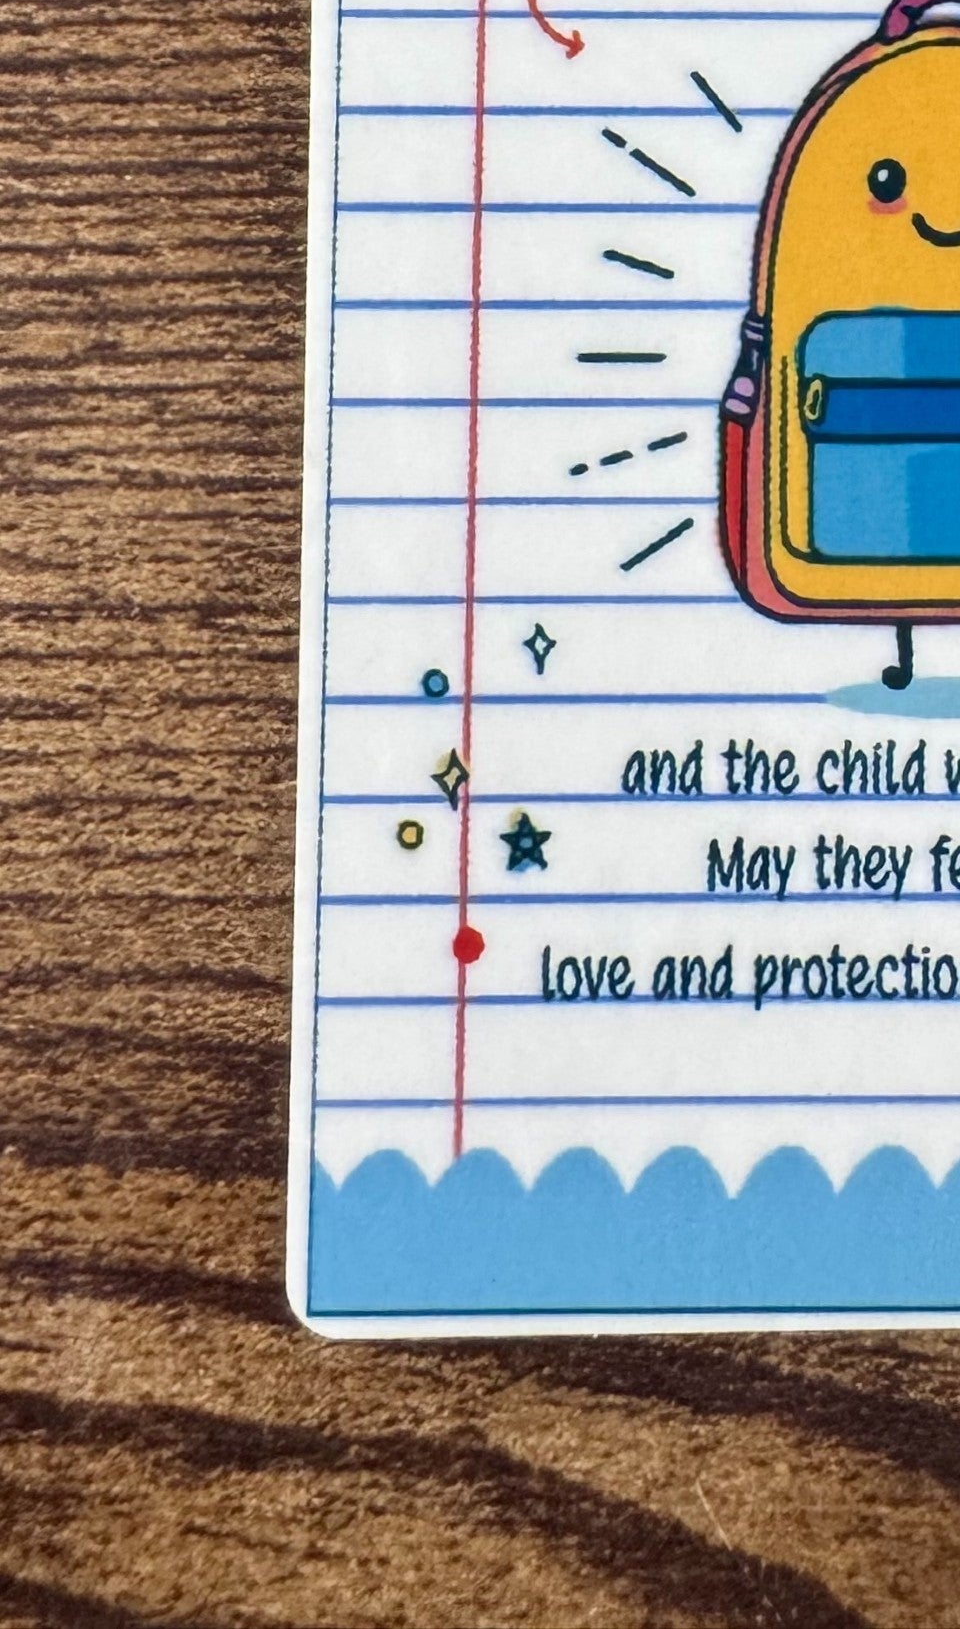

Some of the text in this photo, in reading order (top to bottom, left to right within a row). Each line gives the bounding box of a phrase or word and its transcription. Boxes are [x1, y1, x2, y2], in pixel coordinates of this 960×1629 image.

[622, 739, 702, 795] and
[722, 739, 798, 795] the
[817, 739, 927, 795] child
[706, 837, 796, 900] May
[814, 837, 911, 901] they
[652, 944, 734, 999] and
